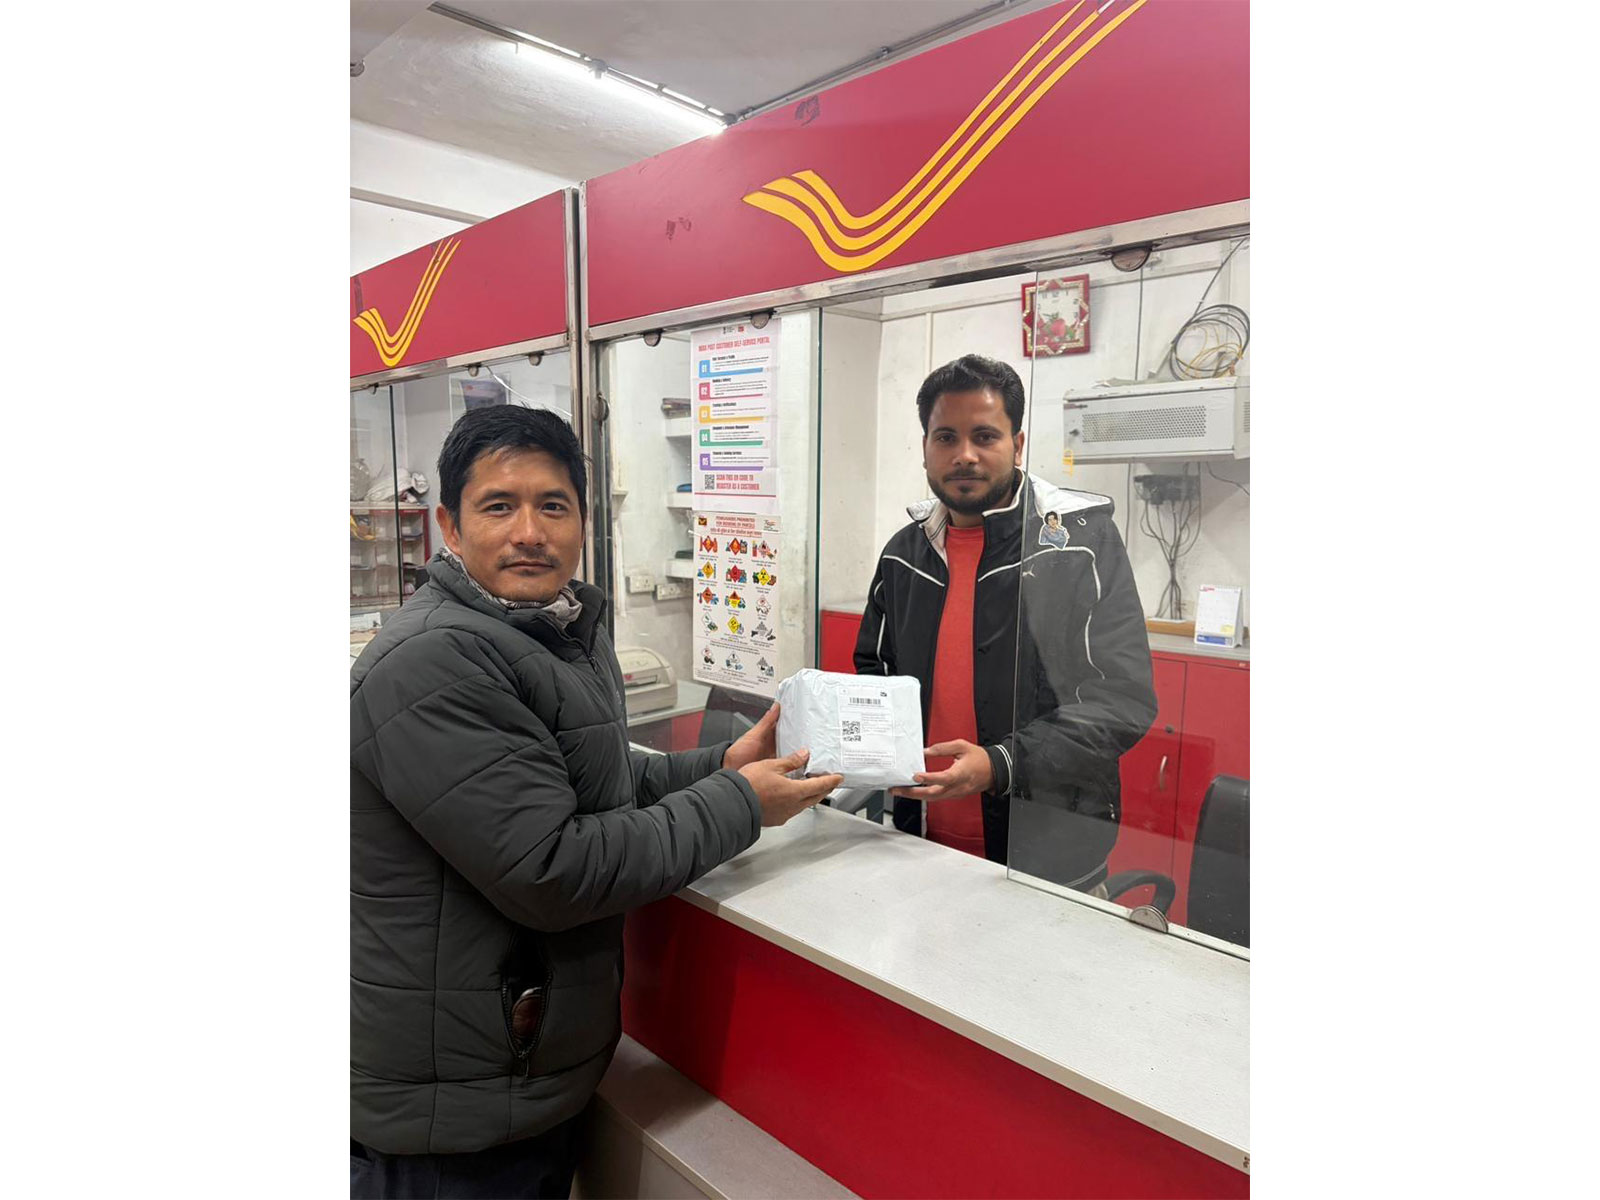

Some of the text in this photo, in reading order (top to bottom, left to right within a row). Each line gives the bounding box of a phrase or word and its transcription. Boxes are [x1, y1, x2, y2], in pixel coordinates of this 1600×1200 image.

[707, 343, 716, 351] POST
[757, 336, 770, 344] PORTAL
[700, 387, 708, 396] 02
[701, 433, 708, 442] 04
[702, 457, 709, 466] 05
[716, 482, 731, 490] REGISTER
[740, 483, 760, 491] CUSTOMER
